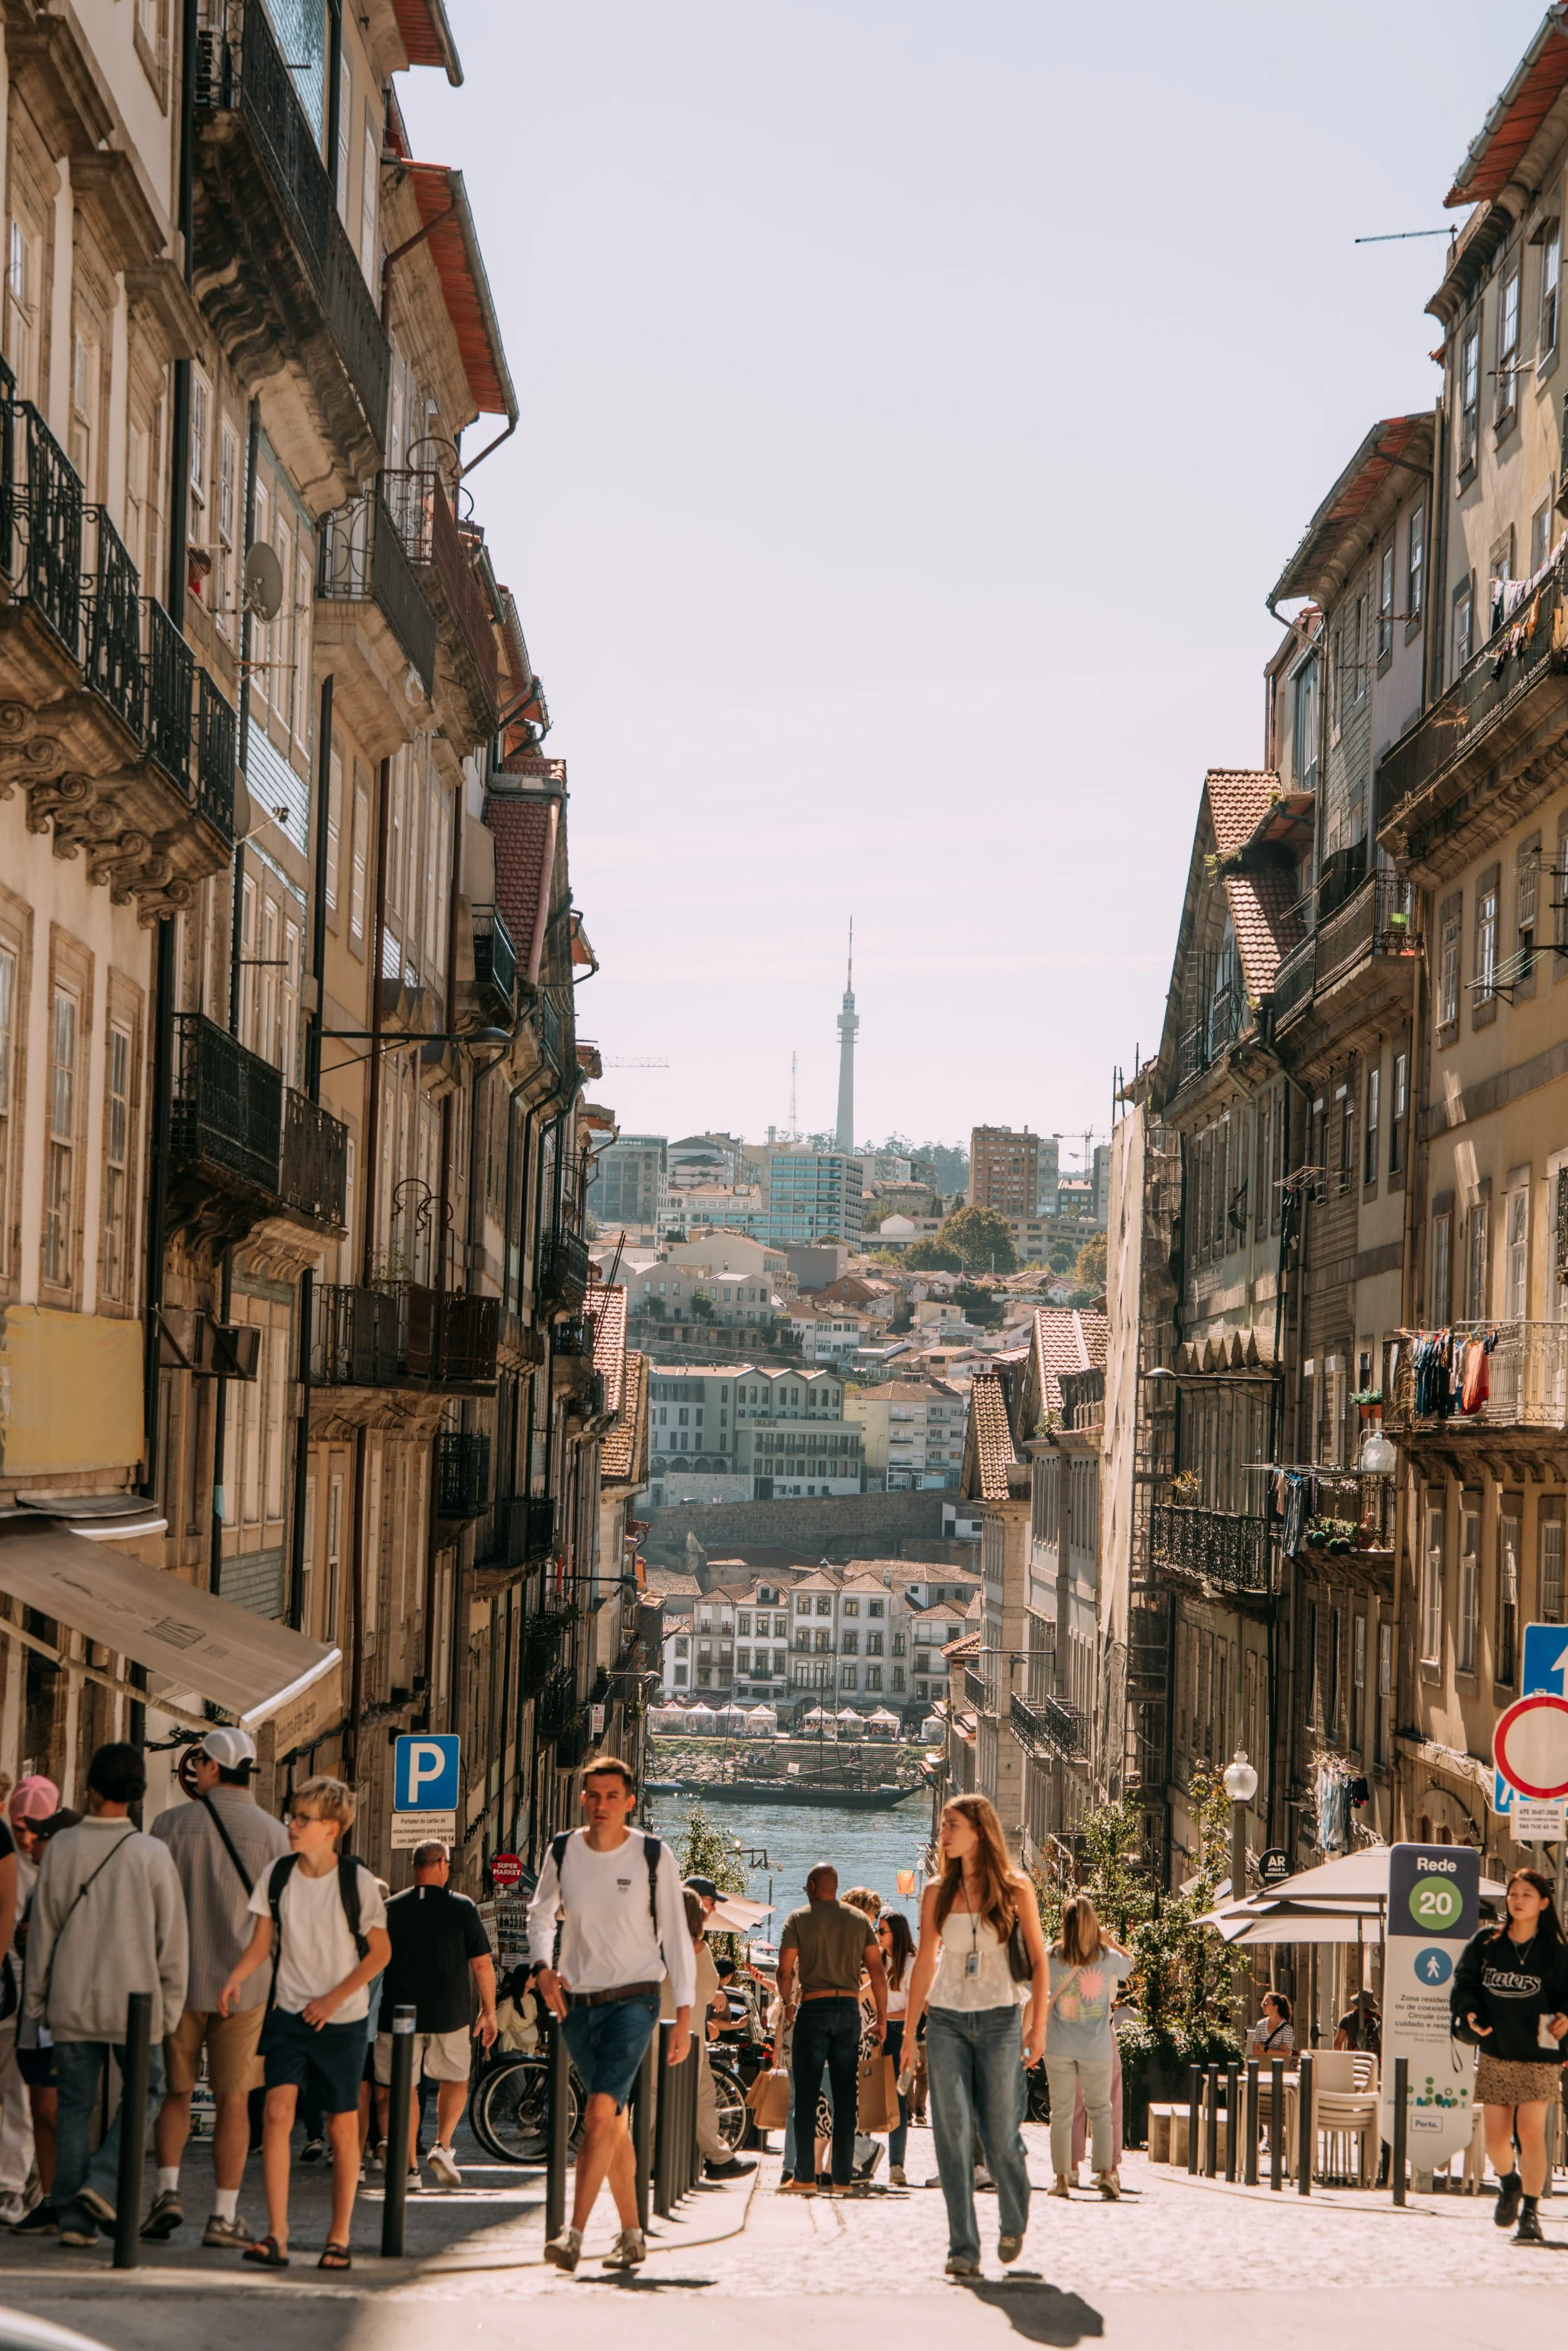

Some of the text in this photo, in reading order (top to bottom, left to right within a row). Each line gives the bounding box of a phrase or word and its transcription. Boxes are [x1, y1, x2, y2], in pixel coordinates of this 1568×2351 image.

[662, 1615, 690, 1625] PKE
[408, 1743, 445, 1803] P
[1268, 1855, 1286, 1867] AR
[1417, 1857, 1457, 1872] Rede
[1419, 1891, 1453, 1916] 20
[1408, 2012, 1434, 2020] Circule
[1415, 2120, 1438, 2128] Porto.
